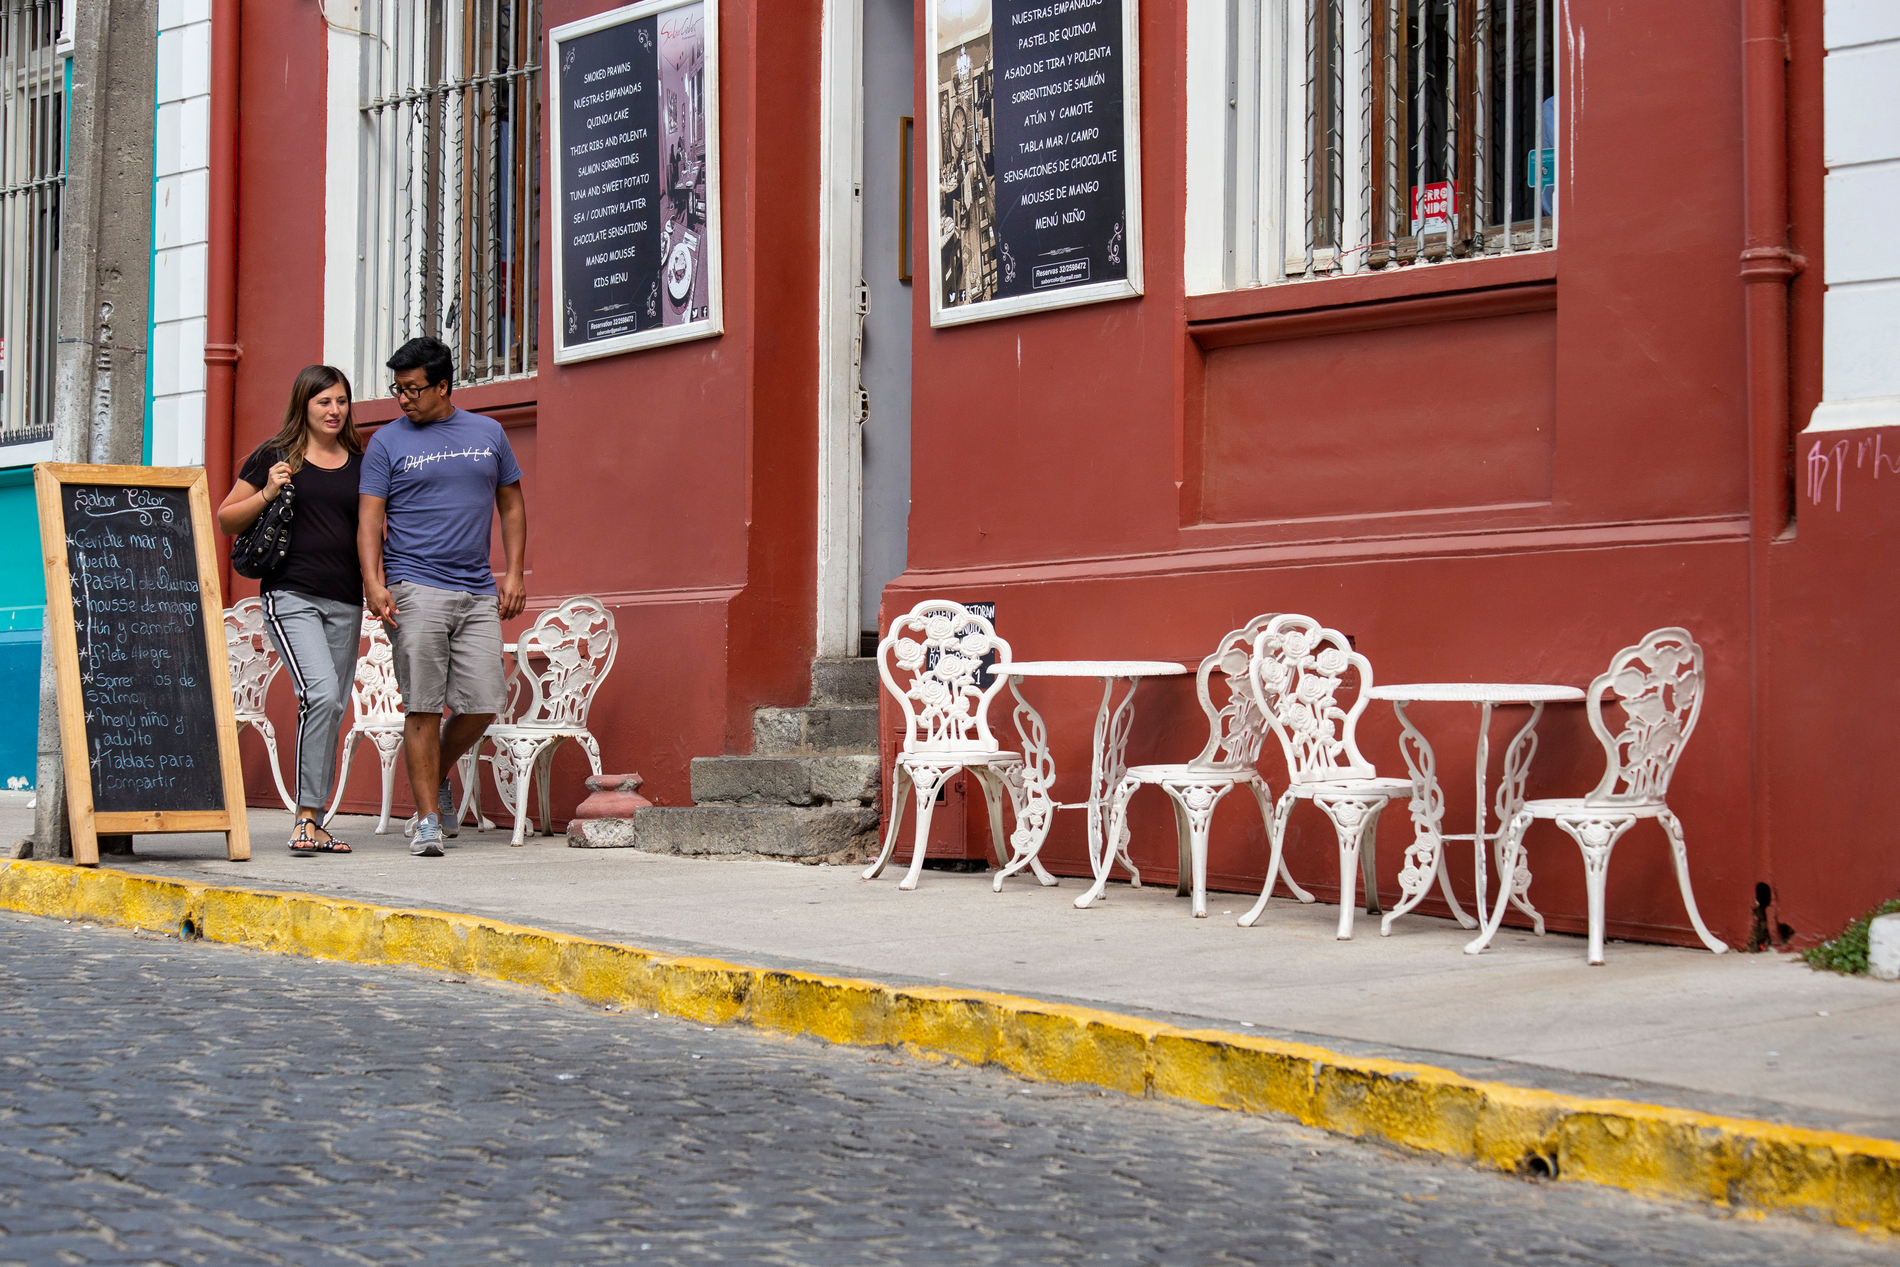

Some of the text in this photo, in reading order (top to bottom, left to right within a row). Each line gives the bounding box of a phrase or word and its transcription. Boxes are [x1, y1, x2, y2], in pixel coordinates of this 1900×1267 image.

[1012, 6, 1052, 26] NUESTRAS
[1018, 22, 1096, 50] PASTEL DE QUINOA
[584, 62, 631, 84] SMOKED PRAWNS
[1004, 46, 1112, 80] ASADO DE TIRA Y POLENTA
[574, 82, 642, 110] NUESTRAS EMPANADAS
[1012, 71, 1105, 104] SORRENTINOS DE SALMÓN
[587, 108, 630, 130] QUINOA CAKE
[1024, 100, 1094, 127] ATÚN Y CAMOTE
[570, 128, 648, 157] THICK RIBS AND POLENTA
[1019, 138, 1044, 154] TABLA
[1046, 134, 1064, 148] MAR
[1070, 127, 1099, 143] CAMPO
[578, 152, 640, 178] SALMON SORRENTINES
[1004, 150, 1118, 184] SENSACIONES DE CHOCOLATE
[570, 173, 650, 202] TUNA AND SWEET POTATO
[1021, 180, 1100, 206] MOUSSE DE MANGO
[573, 212, 586, 224] SEA
[590, 203, 618, 220] COUNTRY
[620, 197, 647, 214] PLATTER
[1035, 208, 1086, 230] MENÚ NIÑO
[573, 220, 648, 246] CHOCOLATE SENSATIONS
[586, 246, 636, 267] MANGO MOUSSE
[593, 272, 628, 289] KIDS MENU
[1036, 268, 1058, 278] Reservas
[74, 488, 166, 511] Sabor Color
[130, 534, 157, 550] mar
[162, 537, 173, 560] y
[141, 596, 157, 613] de
[158, 601, 198, 626] mango
[117, 622, 128, 644] y
[180, 667, 196, 688] de
[140, 712, 168, 726] niño
[175, 715, 184, 734] y
[104, 728, 152, 746] adulto
[101, 749, 194, 770] Tablas para
